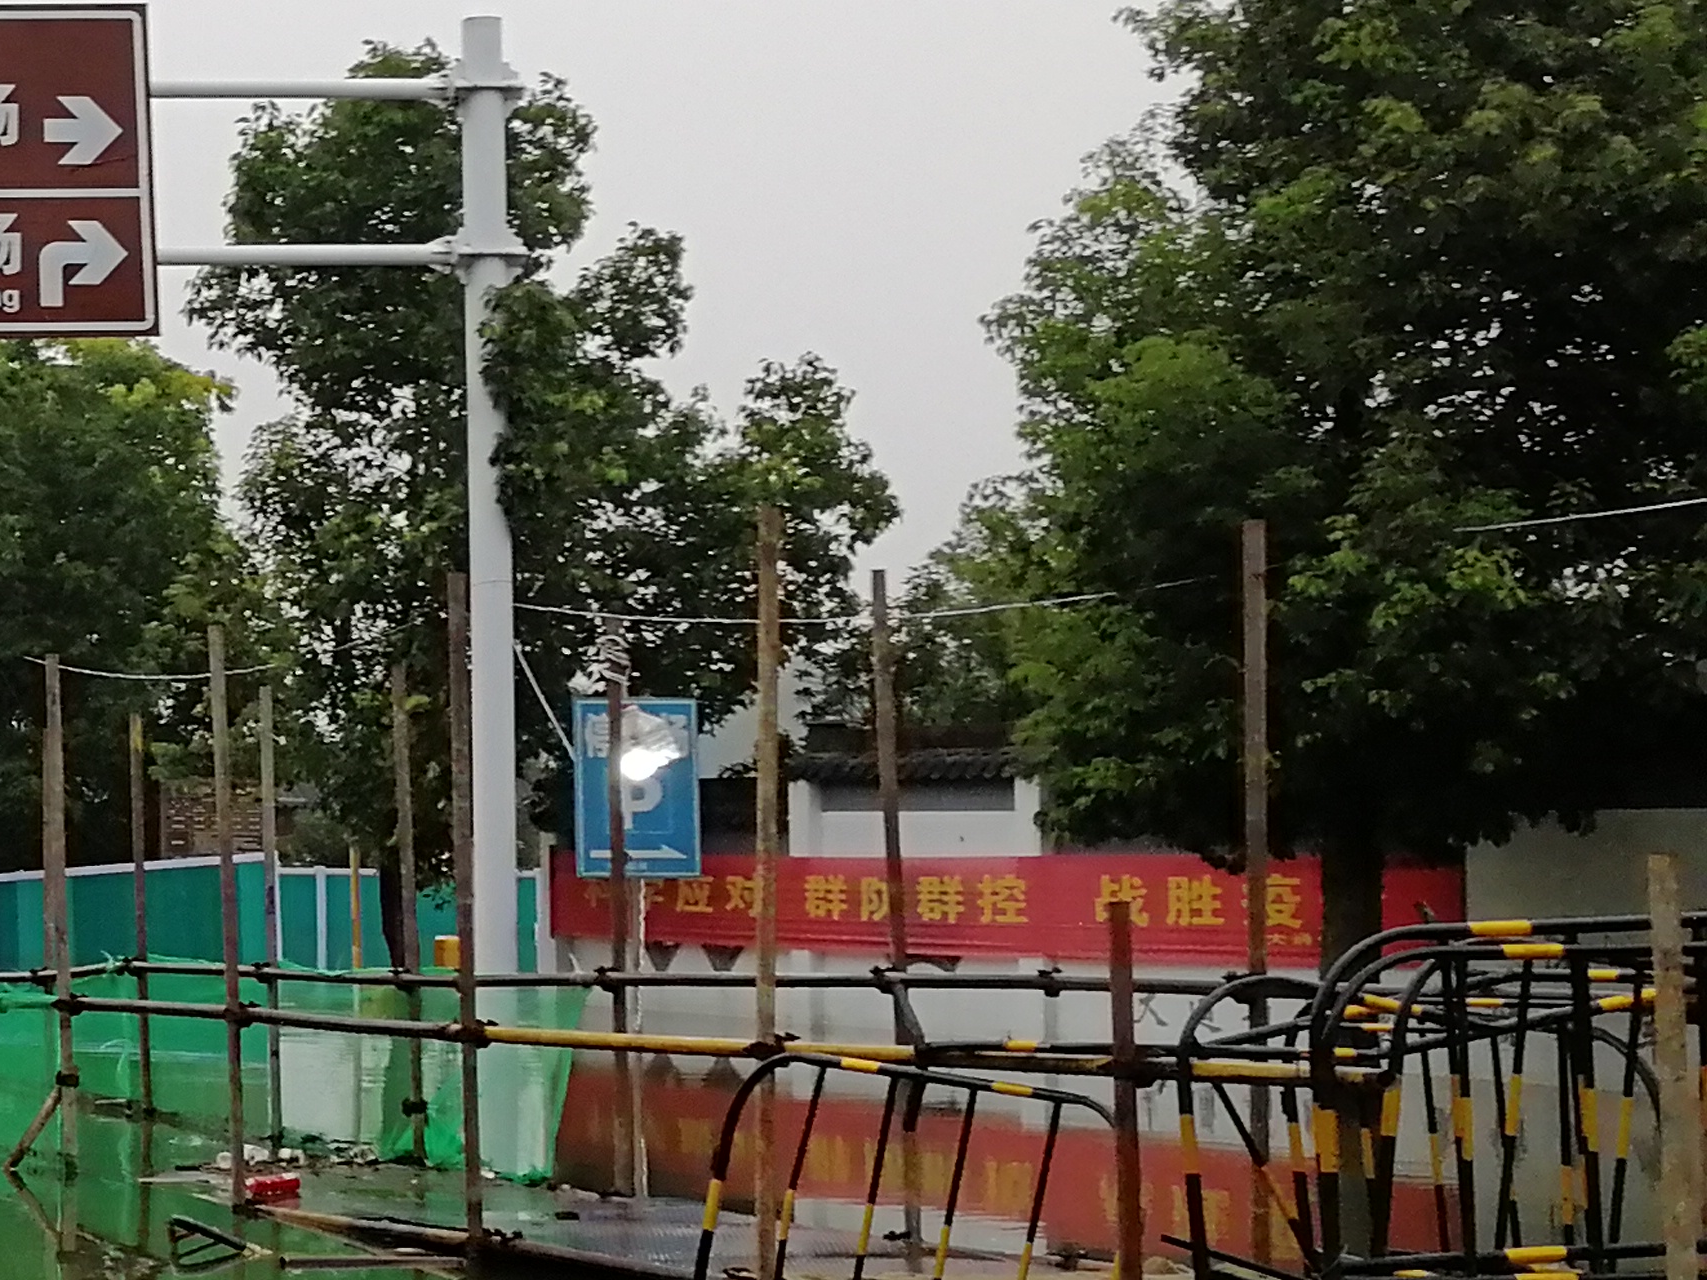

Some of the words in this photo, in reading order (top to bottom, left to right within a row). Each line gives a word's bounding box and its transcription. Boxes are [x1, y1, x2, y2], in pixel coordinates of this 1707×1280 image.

[803, 875, 1027, 925] 群防群控
[1094, 874, 1304, 929] 战胜疫
